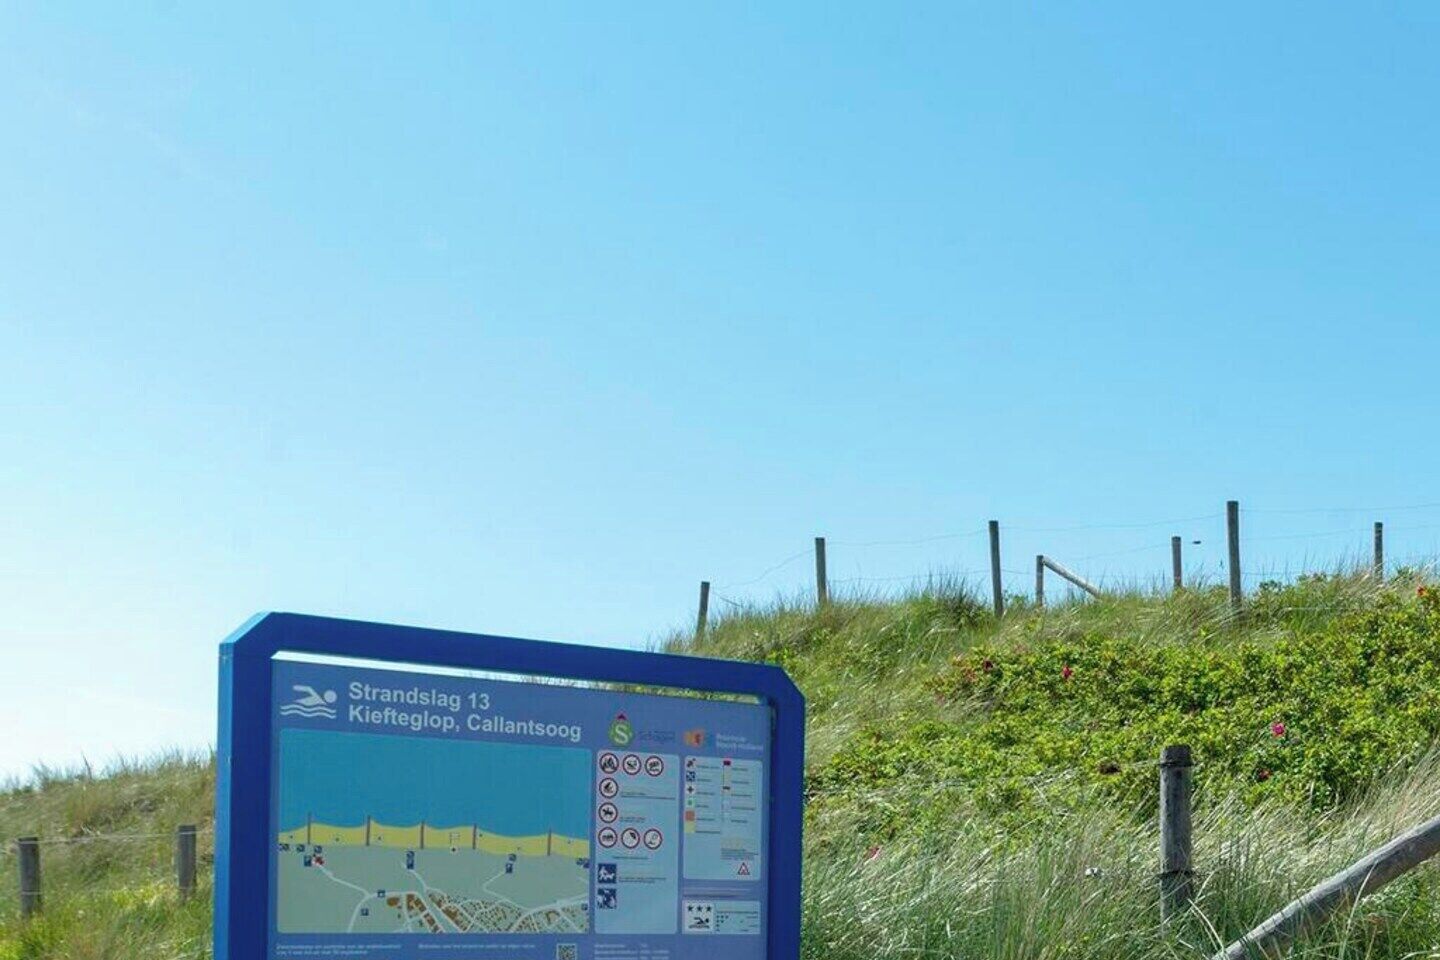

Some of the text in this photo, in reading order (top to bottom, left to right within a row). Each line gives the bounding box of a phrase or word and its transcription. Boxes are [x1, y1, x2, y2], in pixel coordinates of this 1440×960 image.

[349, 682, 490, 712] Strandslag 13
[349, 705, 582, 742] Kiefteglop, Callantsoog
